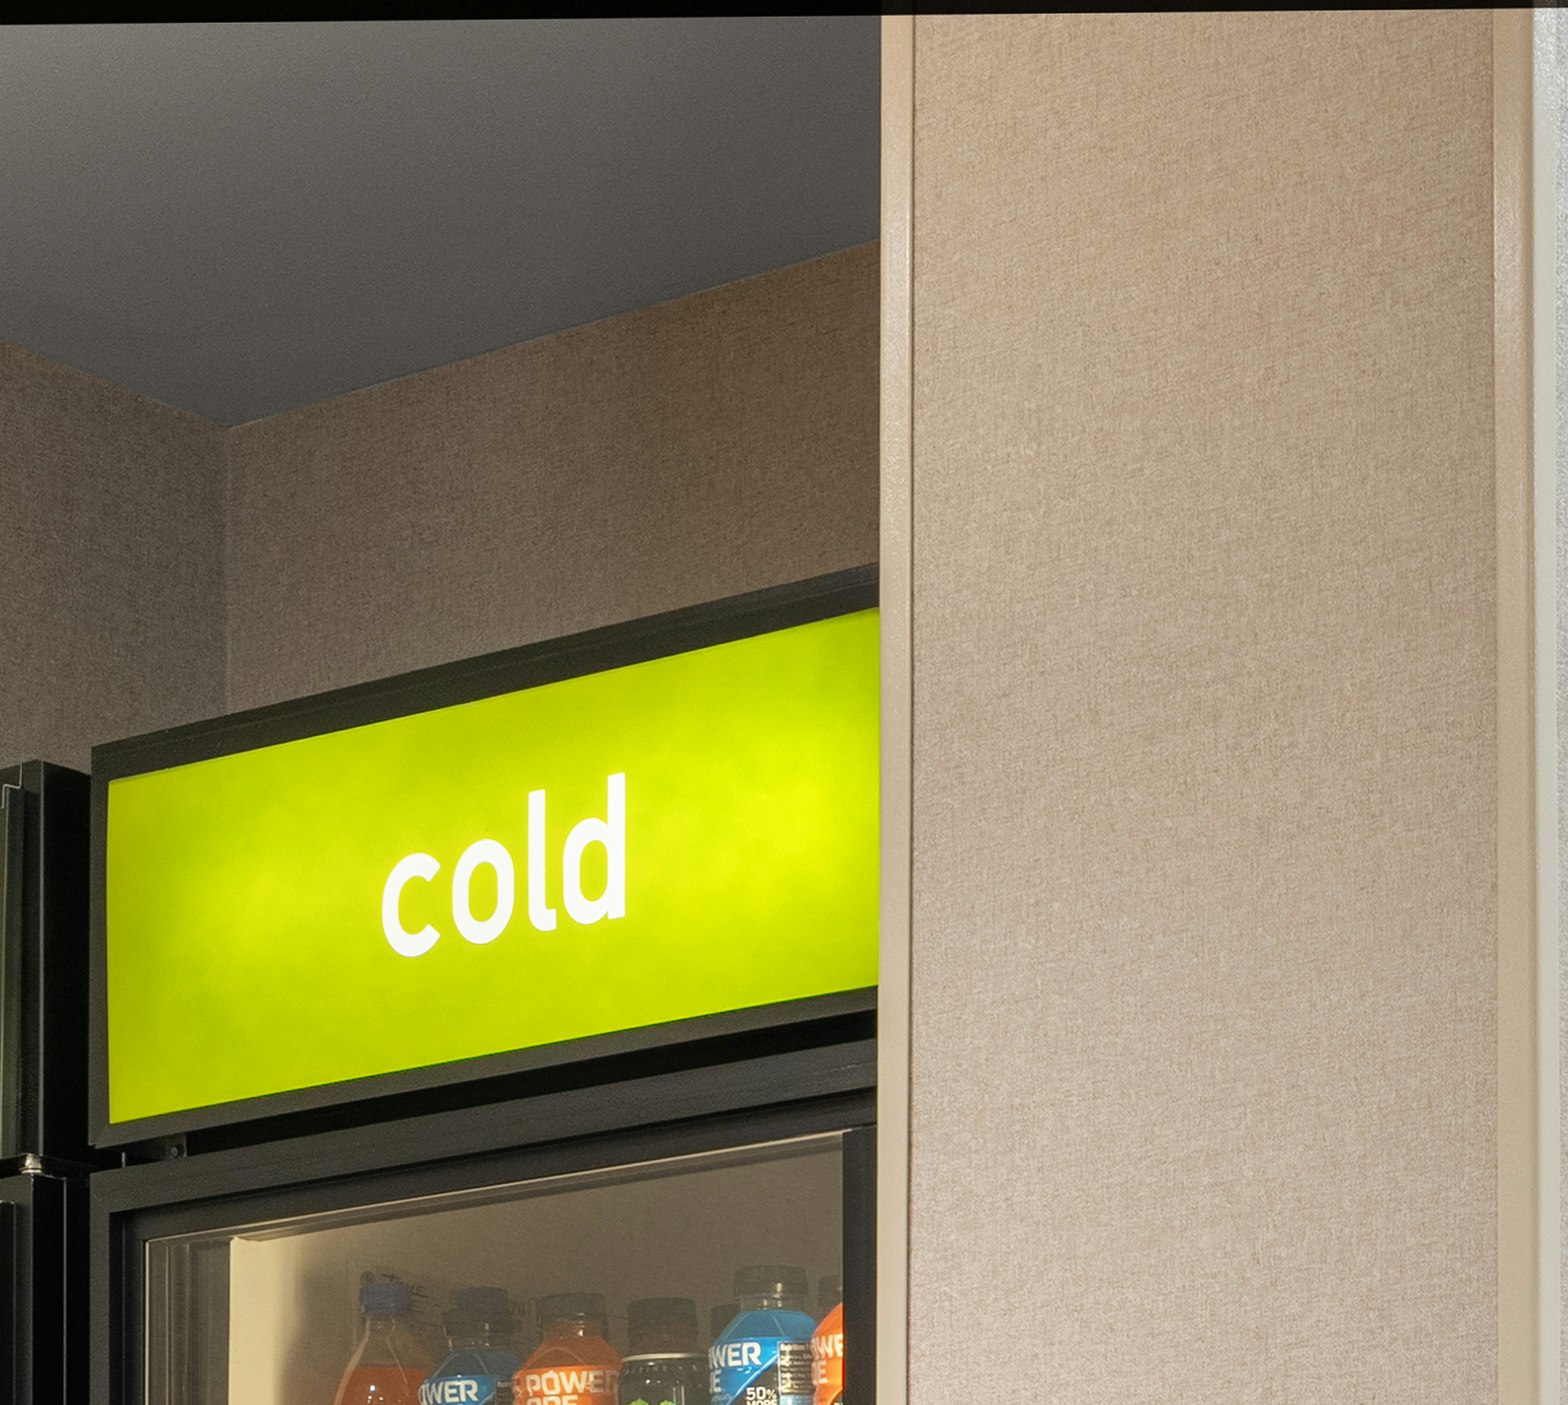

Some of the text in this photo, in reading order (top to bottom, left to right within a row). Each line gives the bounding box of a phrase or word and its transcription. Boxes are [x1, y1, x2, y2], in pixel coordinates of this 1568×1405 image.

[381, 772, 628, 958] cold
[418, 1380, 479, 1405] OWER
[746, 1386, 777, 1401] 50%
